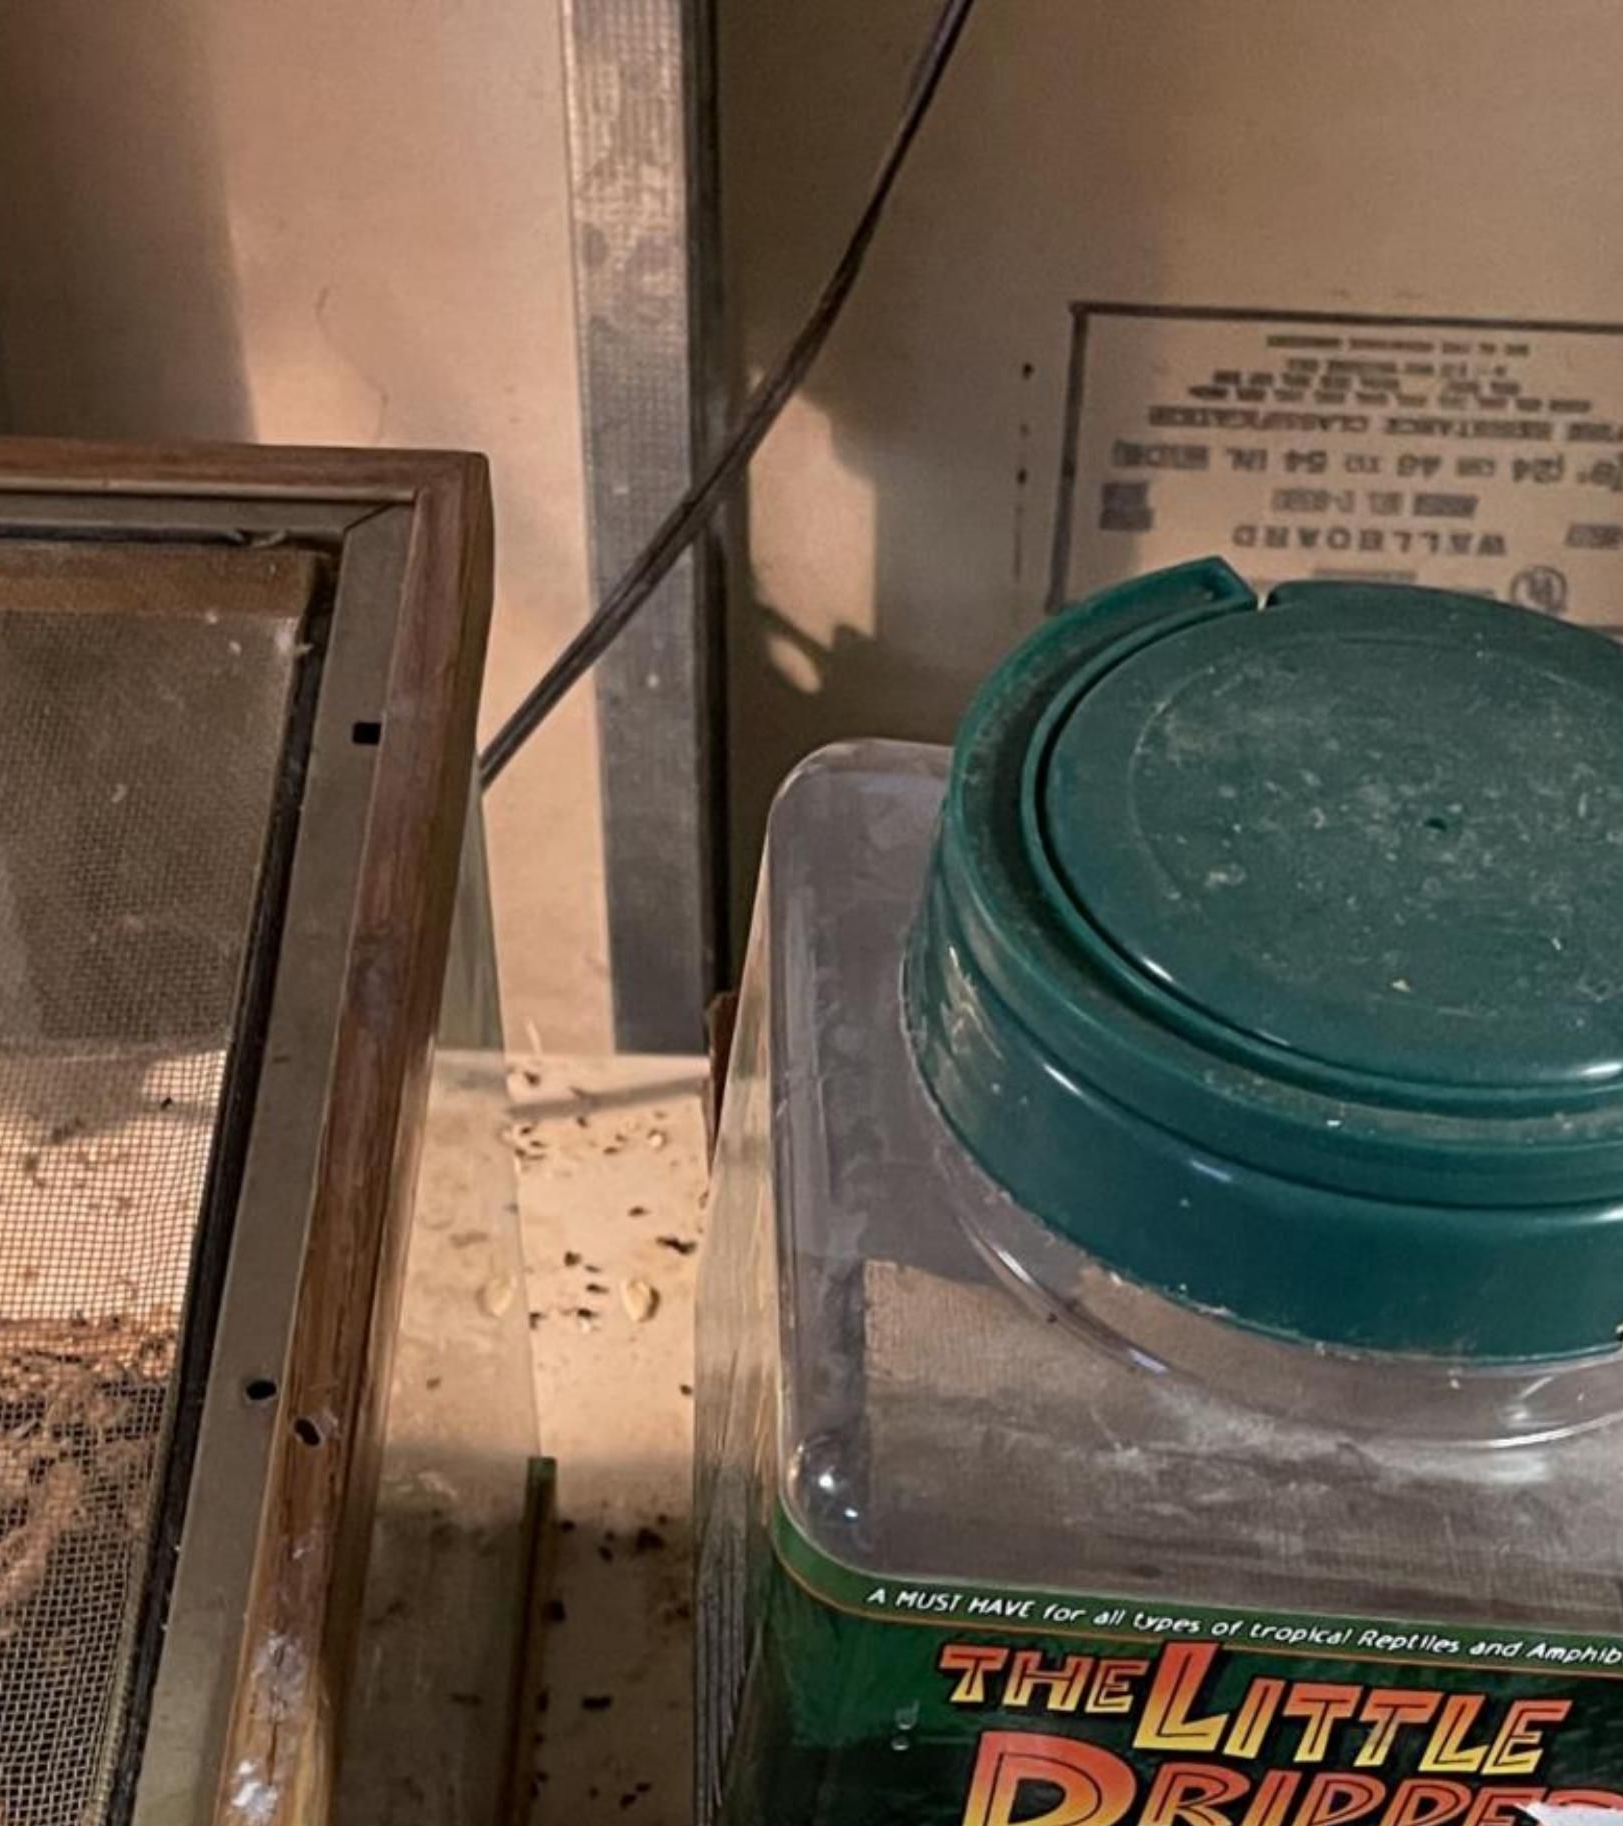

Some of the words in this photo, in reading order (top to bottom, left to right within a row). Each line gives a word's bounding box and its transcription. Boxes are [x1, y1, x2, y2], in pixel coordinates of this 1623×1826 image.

[1232, 525, 1506, 555] WALLBOARD
[868, 1587, 887, 1605] A
[895, 1589, 959, 1611] MUST
[967, 1596, 1034, 1618] HAVE
[1041, 1602, 1086, 1624] for
[1092, 1607, 1127, 1627] all
[1133, 1610, 1201, 1637] types
[1210, 1619, 1246, 1638] of
[1249, 1621, 1351, 1648] tropical
[1357, 1629, 1461, 1655] Reptiles
[1469, 1641, 1524, 1658] and
[940, 1645, 1149, 1714] THE
[1133, 1642, 1573, 1775] LITTLE
